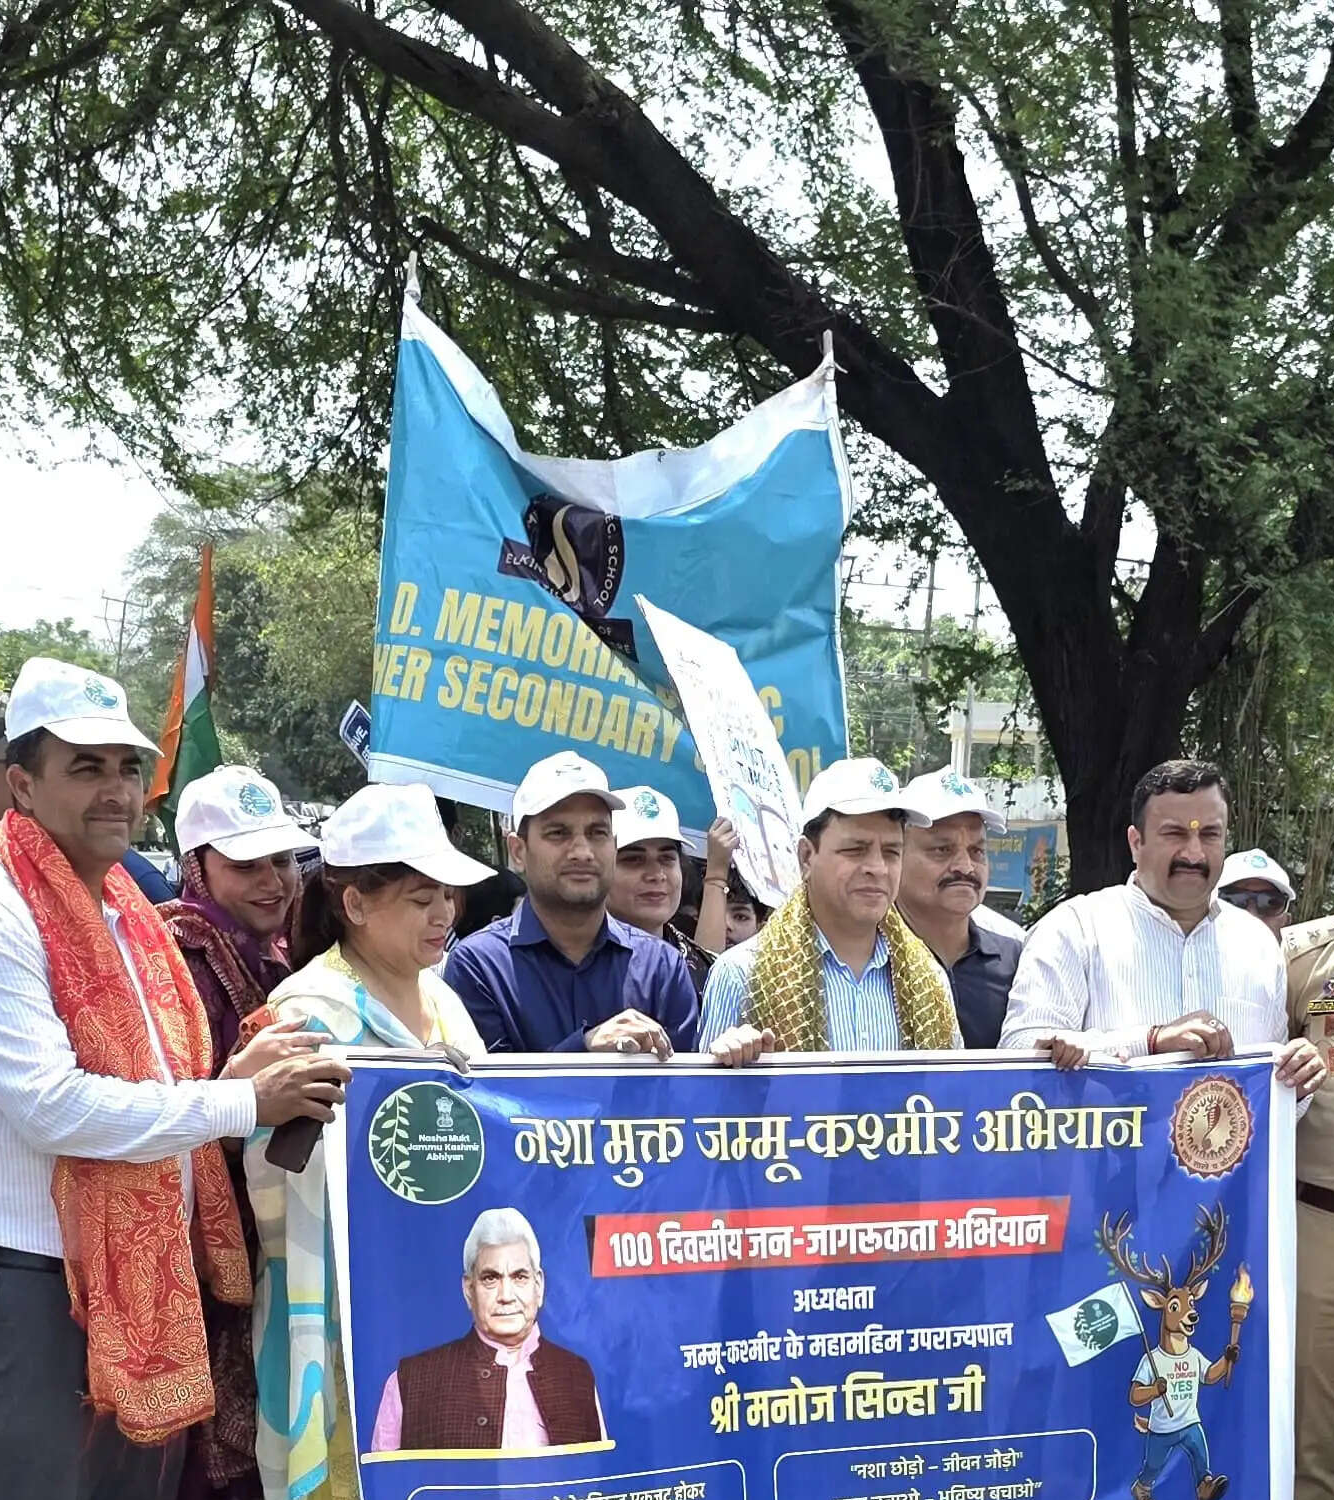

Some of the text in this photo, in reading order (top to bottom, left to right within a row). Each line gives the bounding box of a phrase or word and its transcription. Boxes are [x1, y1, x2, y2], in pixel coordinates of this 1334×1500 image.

[593, 544, 618, 608] SCHOOL
[373, 643, 432, 702] HER
[437, 655, 684, 763] SECONDARY
[407, 1143, 481, 1152] Jammu Kashmir
[418, 1134, 471, 1143] Nasha Mukt
[510, 1115, 595, 1169] नशा
[600, 1116, 685, 1187] मुक्त
[694, 1094, 963, 1182] जम्मू-कश्मीर
[972, 1091, 1147, 1154] अभियान
[425, 1152, 464, 1163] Abhiyan
[610, 1206, 1049, 1268] 100 दिवसीय जन-जागरूकता अभियान
[793, 1284, 876, 1314] अध्यक्षता
[680, 1321, 1014, 1374] जम्मू-कश्मीर के महामहिम उपराज्यपाल
[1174, 1361, 1189, 1371] NO
[709, 1364, 985, 1434] श्री मनोज सिन्हा जी
[1171, 1380, 1193, 1392] YES
[890, 1454, 925, 1480] छोड़ो
[942, 1451, 981, 1474] जीवन
